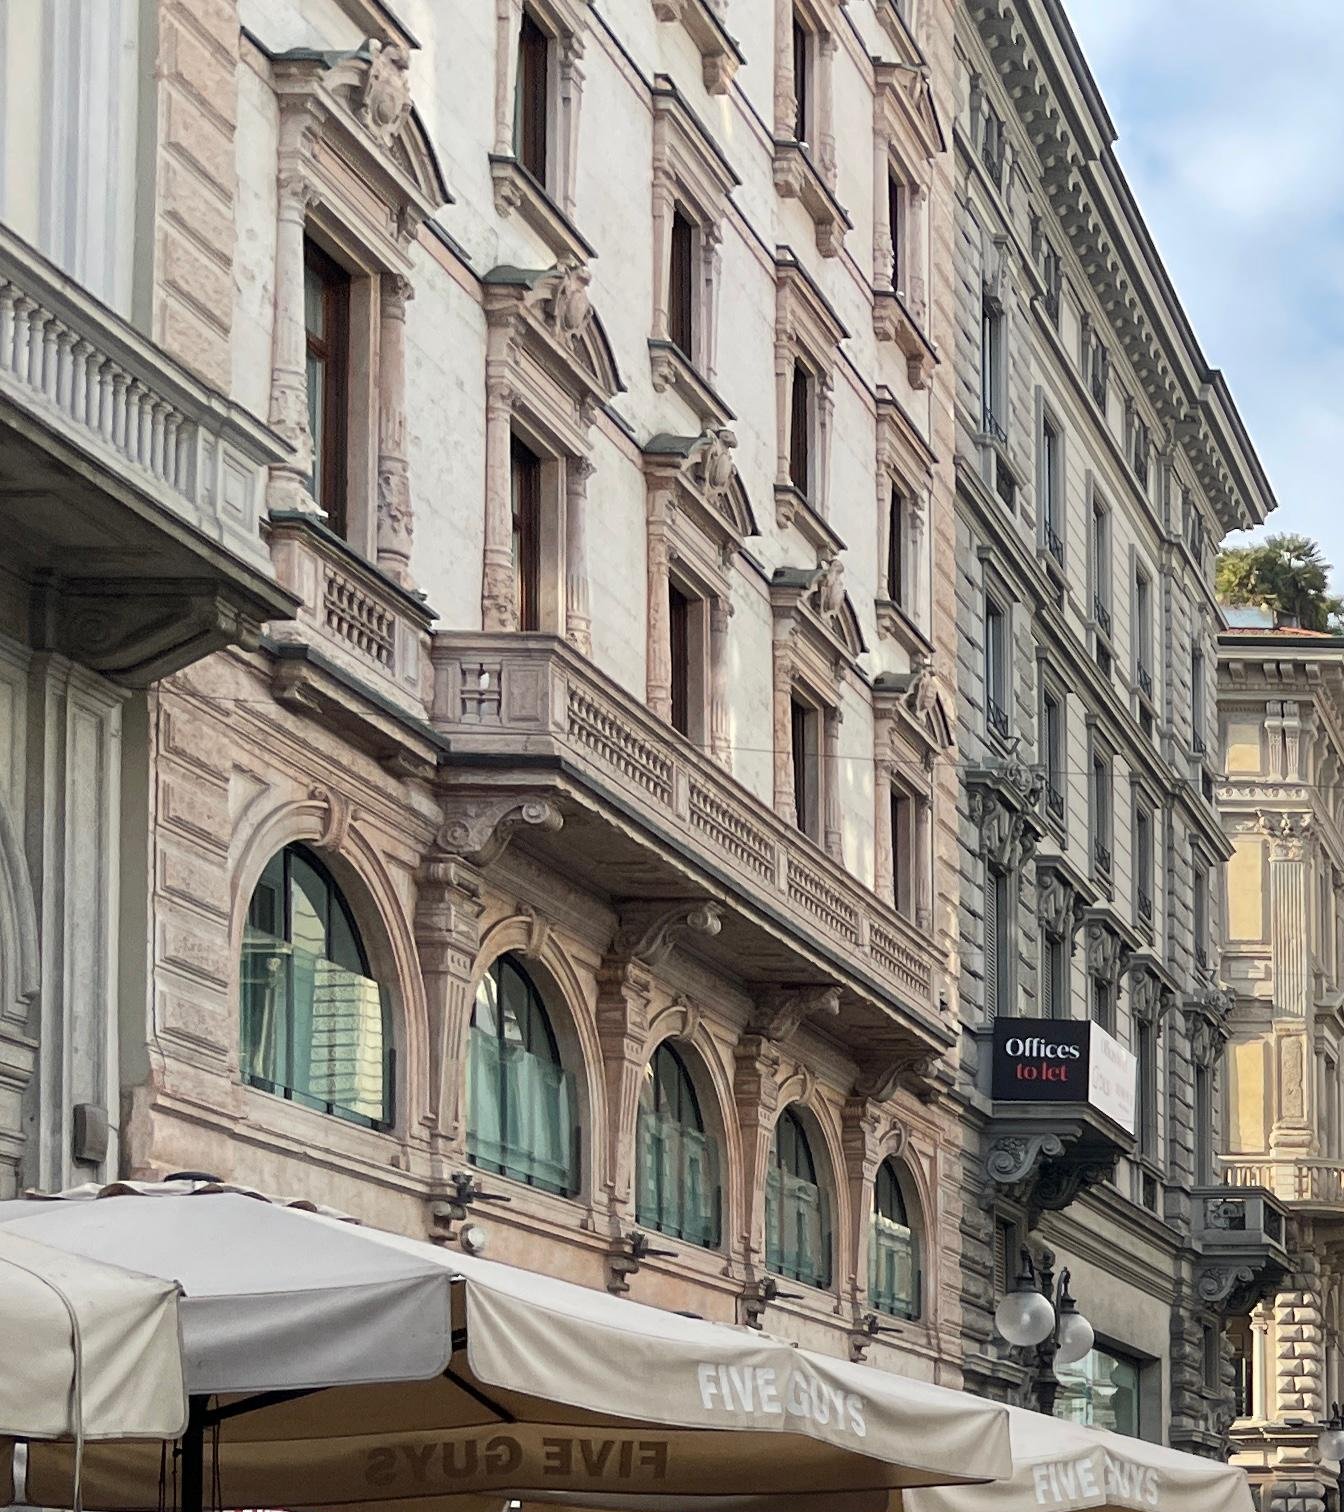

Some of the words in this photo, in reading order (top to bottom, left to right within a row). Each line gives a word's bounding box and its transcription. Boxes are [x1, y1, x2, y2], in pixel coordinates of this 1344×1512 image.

[1005, 1037, 1080, 1059] Offices
[1016, 1063, 1036, 1080] to
[1042, 1061, 1069, 1082] let
[698, 1361, 783, 1415] FIVE
[786, 1370, 867, 1439] GUYS
[1032, 1457, 1101, 1505] FIVE
